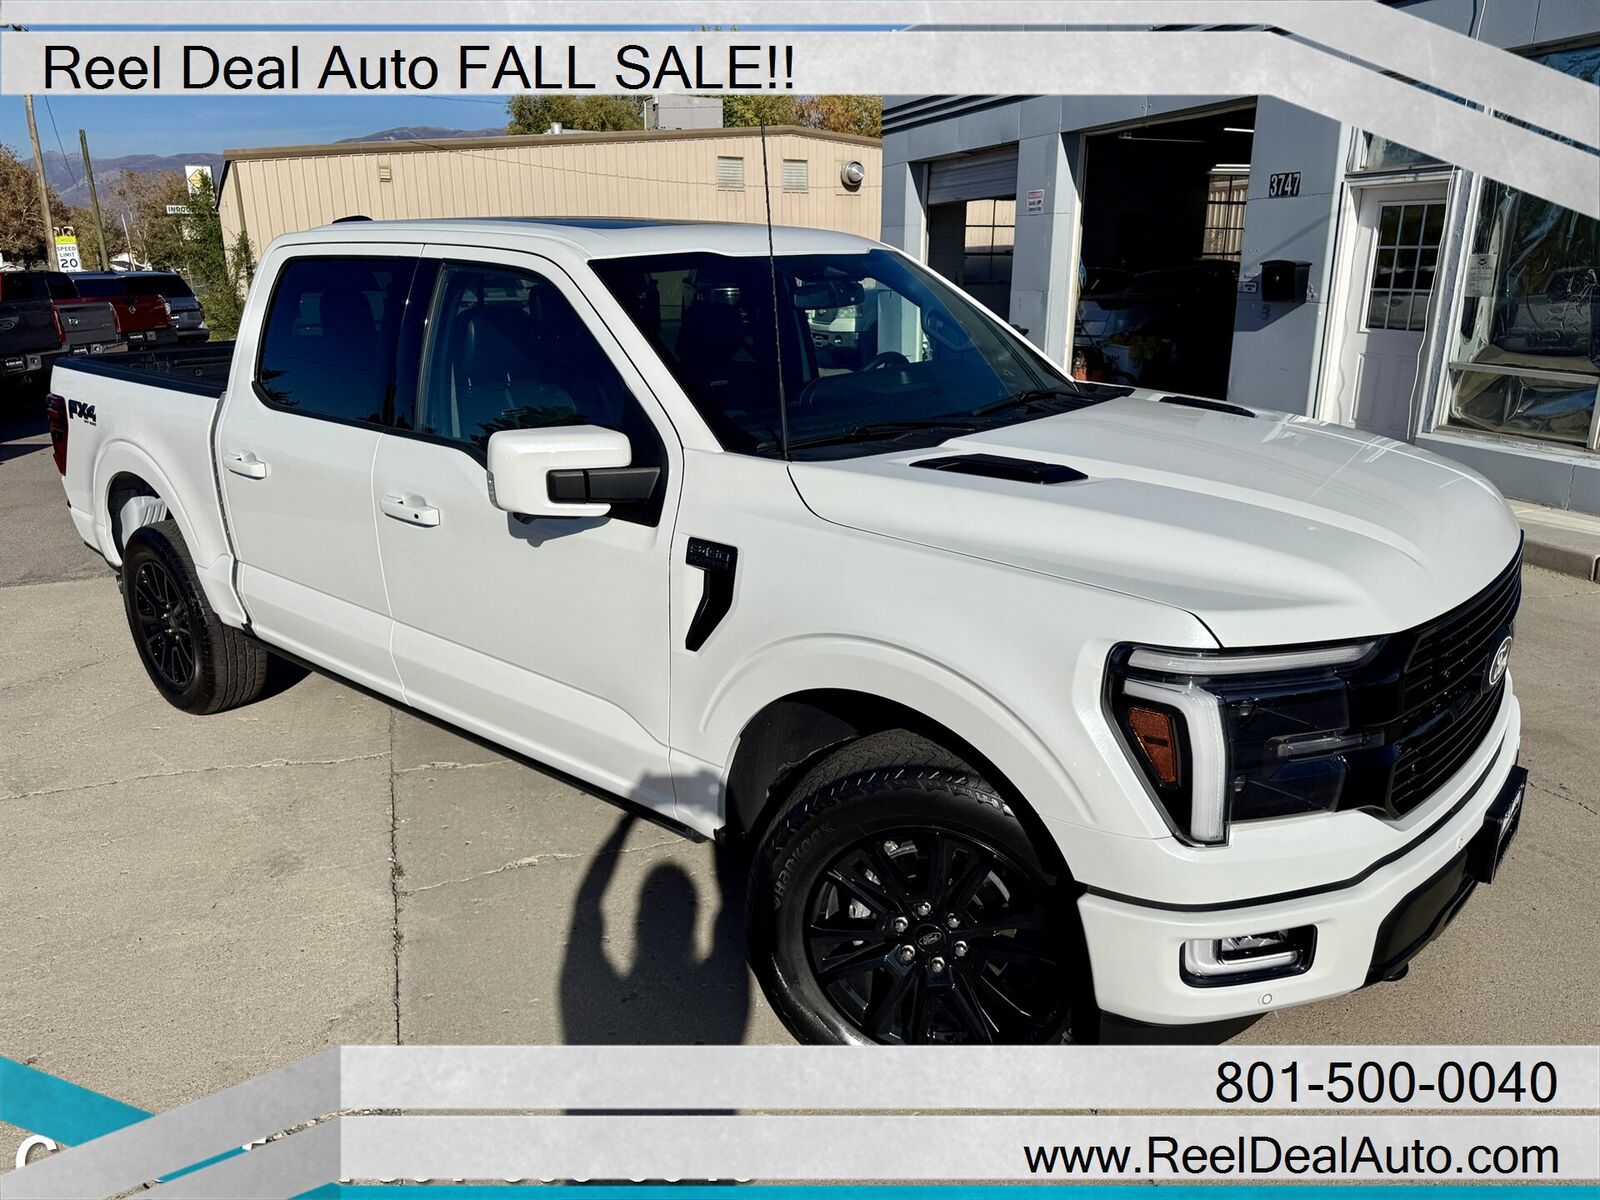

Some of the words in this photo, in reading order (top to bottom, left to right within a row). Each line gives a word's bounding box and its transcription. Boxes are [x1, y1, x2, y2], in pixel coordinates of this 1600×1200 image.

[1270, 174, 1300, 196] 3747
[60, 258, 78, 269] 20
[68, 399, 96, 422] FX4
